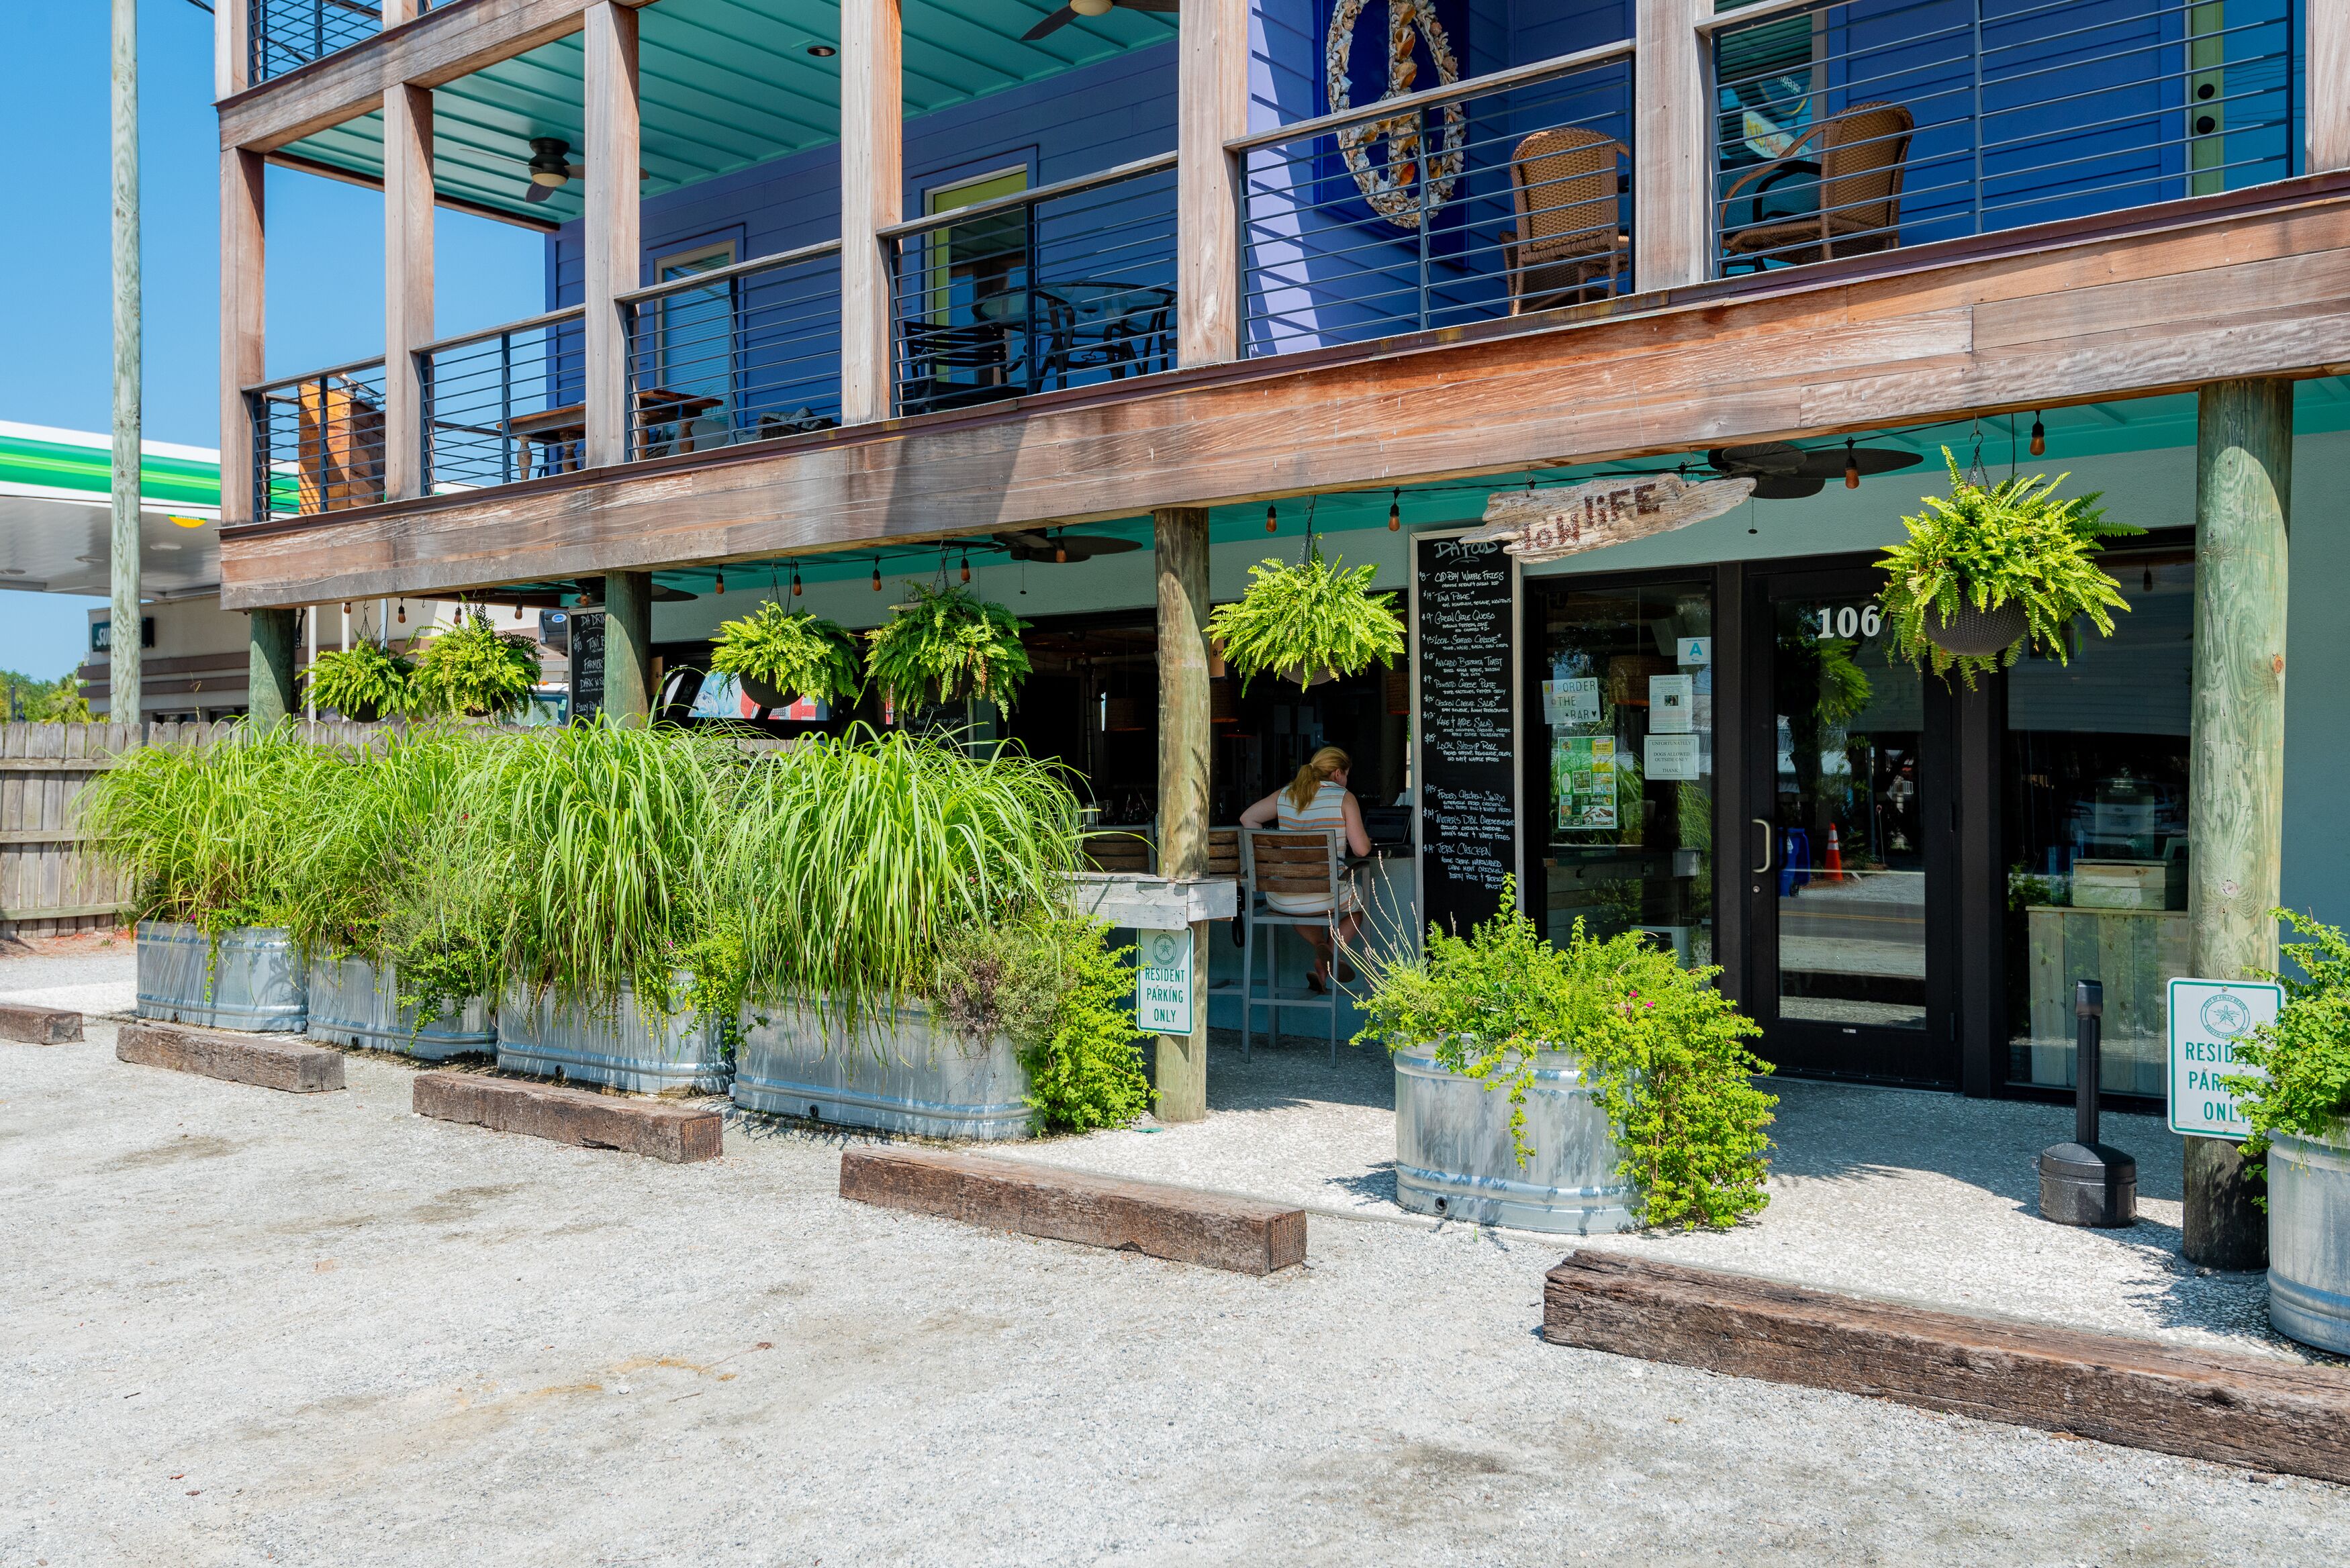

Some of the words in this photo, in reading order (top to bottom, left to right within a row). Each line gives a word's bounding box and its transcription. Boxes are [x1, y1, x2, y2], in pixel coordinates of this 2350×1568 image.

[1483, 570, 1504, 581] FRIES
[1435, 591, 1449, 602] TUNA
[1472, 609, 1495, 621] QUESO
[1818, 605, 1881, 638] 106
[1689, 643, 1702, 656] A
[1484, 656, 1503, 667] TOAST
[1478, 678, 1497, 689] PLATE
[1563, 681, 1595, 692] ORDER
[1558, 696, 1576, 706] THE
[1570, 709, 1589, 719] BAR
[1457, 740, 1479, 750] SHRIMP
[1458, 789, 1483, 799] CHICKEN
[1436, 842, 1455, 854] JERK
[1457, 842, 1491, 856] CHICKEN
[1145, 968, 1184, 983] RESIDENT
[1147, 988, 1183, 1003] PARKING
[1154, 1008, 1176, 1022] ONLY
